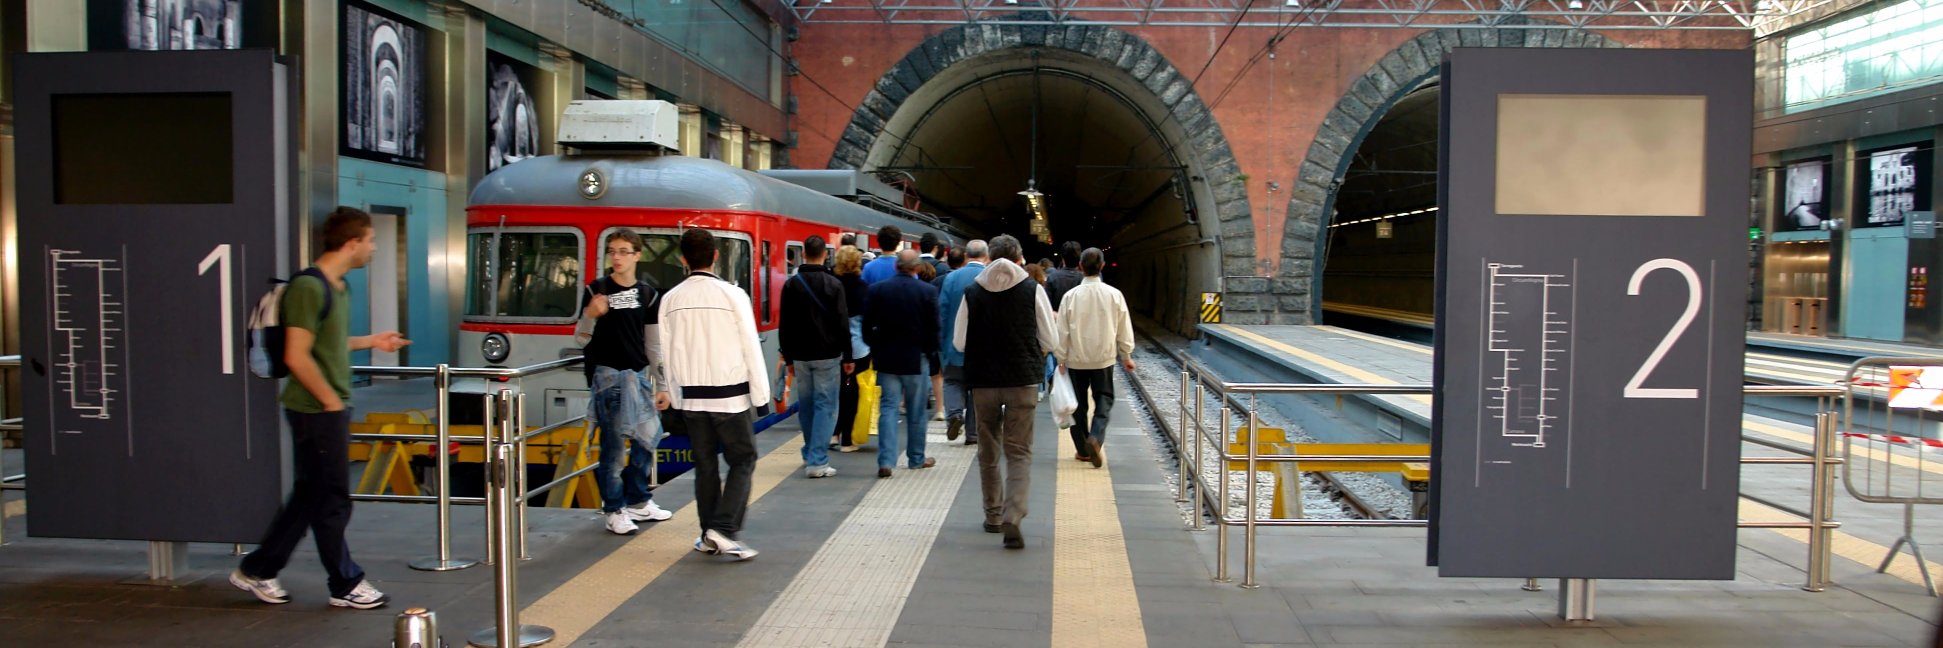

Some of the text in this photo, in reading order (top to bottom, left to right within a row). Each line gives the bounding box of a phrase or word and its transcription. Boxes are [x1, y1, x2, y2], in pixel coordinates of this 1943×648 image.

[198, 244, 234, 375] 1
[1623, 257, 1702, 399] 2
[656, 448, 673, 463] ET
